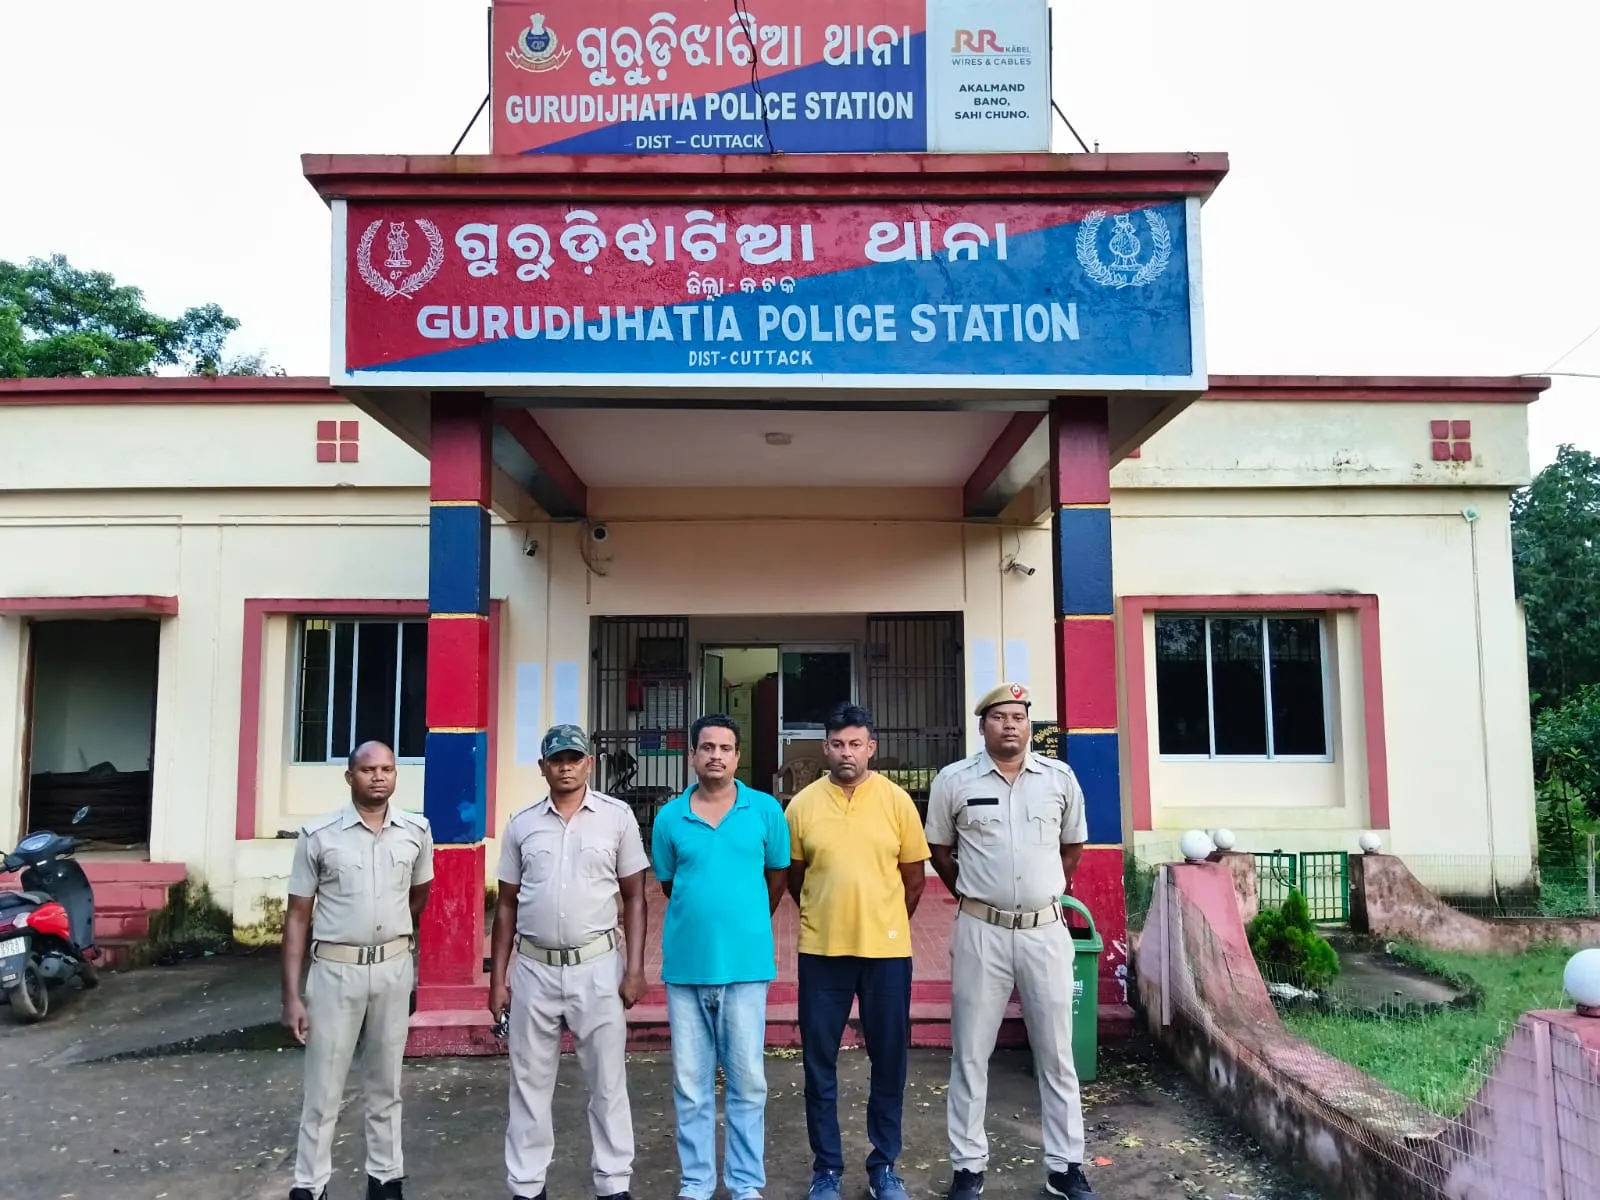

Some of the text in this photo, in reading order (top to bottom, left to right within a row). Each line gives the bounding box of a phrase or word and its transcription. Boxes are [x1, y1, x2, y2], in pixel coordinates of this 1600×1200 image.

[823, 24, 911, 67] ଥାନା
[951, 29, 1005, 53] RR
[951, 58, 1032, 66] WIRES & CABLES
[959, 83, 1026, 93] AKALMAND
[505, 91, 914, 124] GURUDIJHATIA POLICE STATION
[973, 97, 1011, 106] BANO,
[954, 110, 1030, 120] SAHI CHUNO.
[636, 134, 672, 150] DIST
[690, 133, 764, 149] CUTTACK
[864, 220, 1008, 263] ଥାନା
[416, 302, 1080, 343] GURUDIJHATIA POLICE STATION
